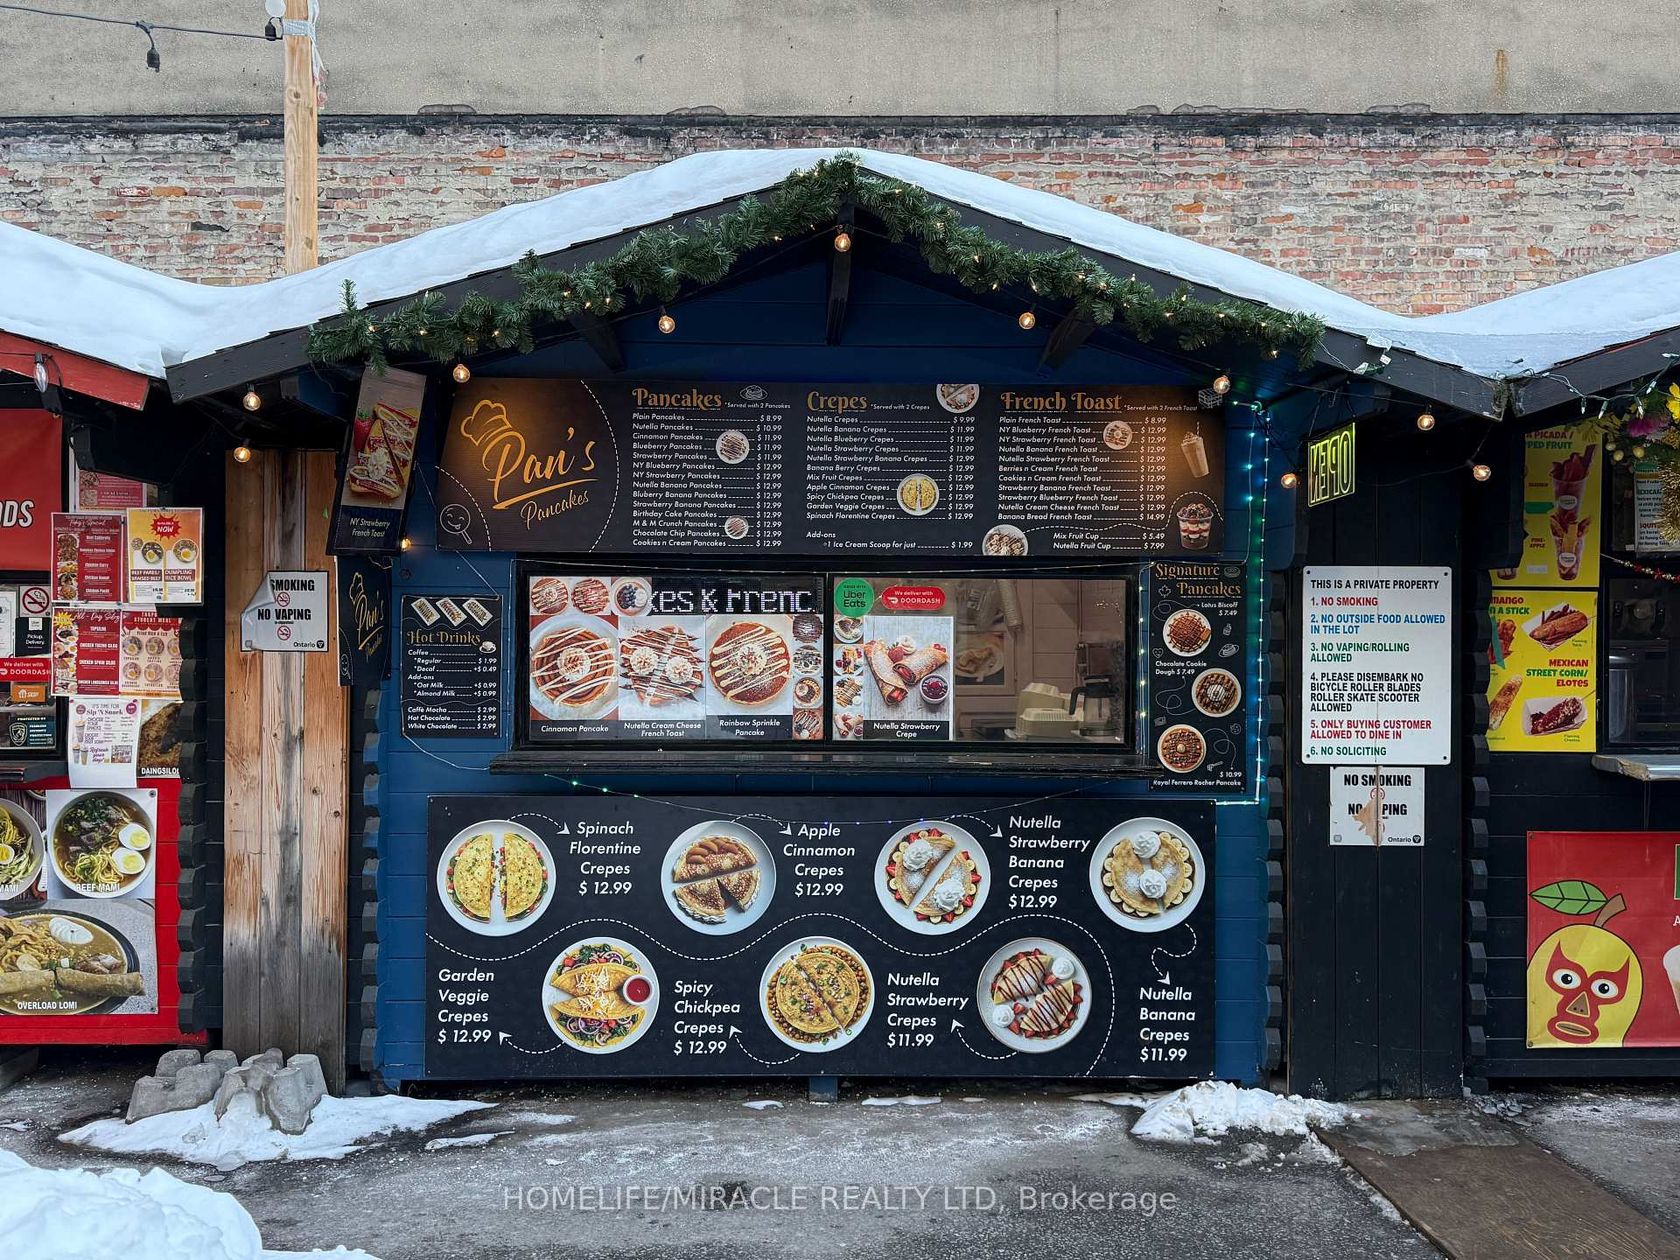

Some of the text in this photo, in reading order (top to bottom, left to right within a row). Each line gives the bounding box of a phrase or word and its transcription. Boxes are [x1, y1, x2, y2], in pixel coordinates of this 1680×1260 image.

[632, 388, 722, 410] Pancakes
[807, 391, 868, 415] Crepes
[1000, 392, 1122, 412] French Toast
[482, 426, 596, 502] Pan's
[806, 493, 825, 501] Spicy
[827, 493, 859, 501] Chickpea
[0, 500, 34, 527] DS
[520, 490, 589, 530] Pancakes
[350, 518, 390, 529] NY Strawberry
[352, 528, 385, 537] French Toast
[1086, 533, 1099, 541] Cup
[1156, 564, 1220, 579] Signature
[1176, 582, 1241, 597] Pancakes
[1311, 580, 1439, 589] THIS IS A PRIVATE PROPERTY
[844, 599, 866, 607] Eats
[1311, 597, 1378, 606] 1. NO SMOKING
[258, 609, 311, 620] NO VAPING
[1311, 614, 1445, 624] 2. NO OUTSIDE FOOD ALLOWED
[1311, 625, 1360, 634] IN THE LOT
[407, 629, 481, 646] Hot Drinks
[1311, 643, 1410, 652] 3. NO VAPING/ROLLING
[1311, 654, 1352, 662] ALLOWED
[1549, 659, 1588, 667] MEXICAN
[1310, 672, 1424, 681] 4. PLEASE DISEMBARK NO
[1526, 669, 1556, 677] STREET
[1311, 683, 1421, 692] BICYCLE ROLLER BLADES
[1311, 693, 1420, 702] ROLLER SKATE SCOOTER
[1311, 703, 1352, 712] ALLOWED
[624, 722, 701, 730] Nutella Cream Cheese
[752, 720, 780, 728] Sprinkle
[874, 722, 941, 732] Nutella Strawberry
[1311, 720, 1432, 729] 5. ONLY BUYING CUSTOMER
[641, 730, 684, 738] French Toast
[896, 730, 917, 739] Crepe
[1311, 730, 1402, 739] ALLOWED TO DINE IN
[1310, 747, 1386, 756] 6. NO SOLICITING
[1344, 774, 1358, 786] NO
[1009, 816, 1062, 829] Nutella
[576, 821, 634, 838] Spinach
[798, 823, 840, 840] Apple
[569, 842, 641, 855] Florentine
[783, 844, 855, 856] Cinnamon
[1009, 836, 1090, 852] Strawberry
[1009, 856, 1064, 869] Banana
[580, 862, 631, 878] Crepes
[795, 863, 844, 879] Crepes
[77, 884, 120, 892] BEEF MAMI
[1009, 876, 1058, 892] Crepes
[438, 969, 495, 982] Garden
[888, 972, 940, 987] Nutella
[674, 981, 713, 997] Spicy
[1139, 987, 1192, 1001] Nutella
[438, 989, 489, 1005] Veggie
[888, 993, 968, 1010] Strawberry
[18, 1001, 77, 1009] OVERLOAD LOMI
[674, 1001, 741, 1017] Chickpea
[438, 1010, 489, 1026] Crepes
[1139, 1008, 1196, 1021] Banana
[888, 1014, 937, 1030] Crepes
[674, 1021, 724, 1037] Crepes
[1139, 1028, 1190, 1044] Crepes
